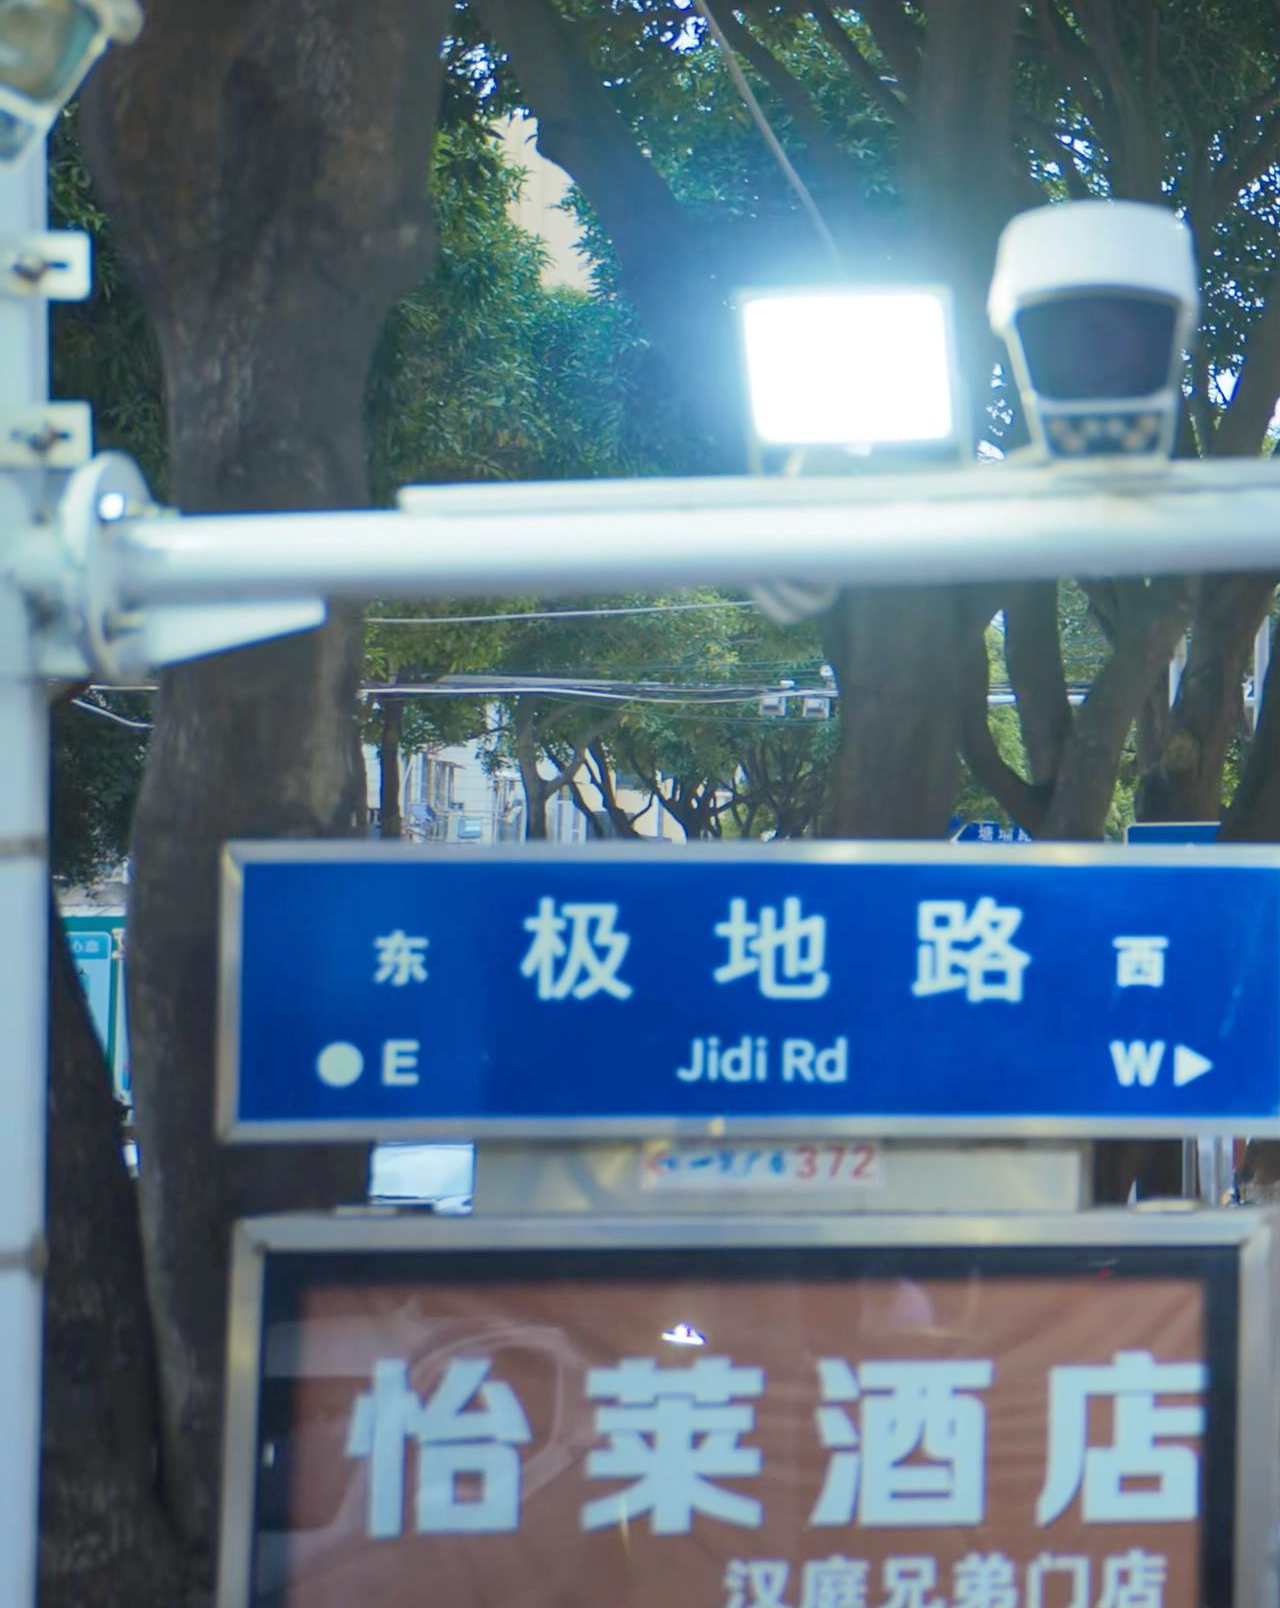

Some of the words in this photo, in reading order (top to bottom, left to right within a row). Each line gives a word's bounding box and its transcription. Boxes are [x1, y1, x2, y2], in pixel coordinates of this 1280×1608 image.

[374, 931, 428, 986] 东
[520, 896, 1032, 1003] 极地路
[1115, 936, 1168, 988] 西
[382, 1042, 419, 1086] E
[676, 1036, 769, 1084] Jidi
[783, 1037, 848, 1084] Rd
[1110, 1042, 1166, 1087] W
[347, 1350, 1208, 1539] 怡莱酒店
[723, 1549, 1168, 1608] 汉庭兄弟门店
